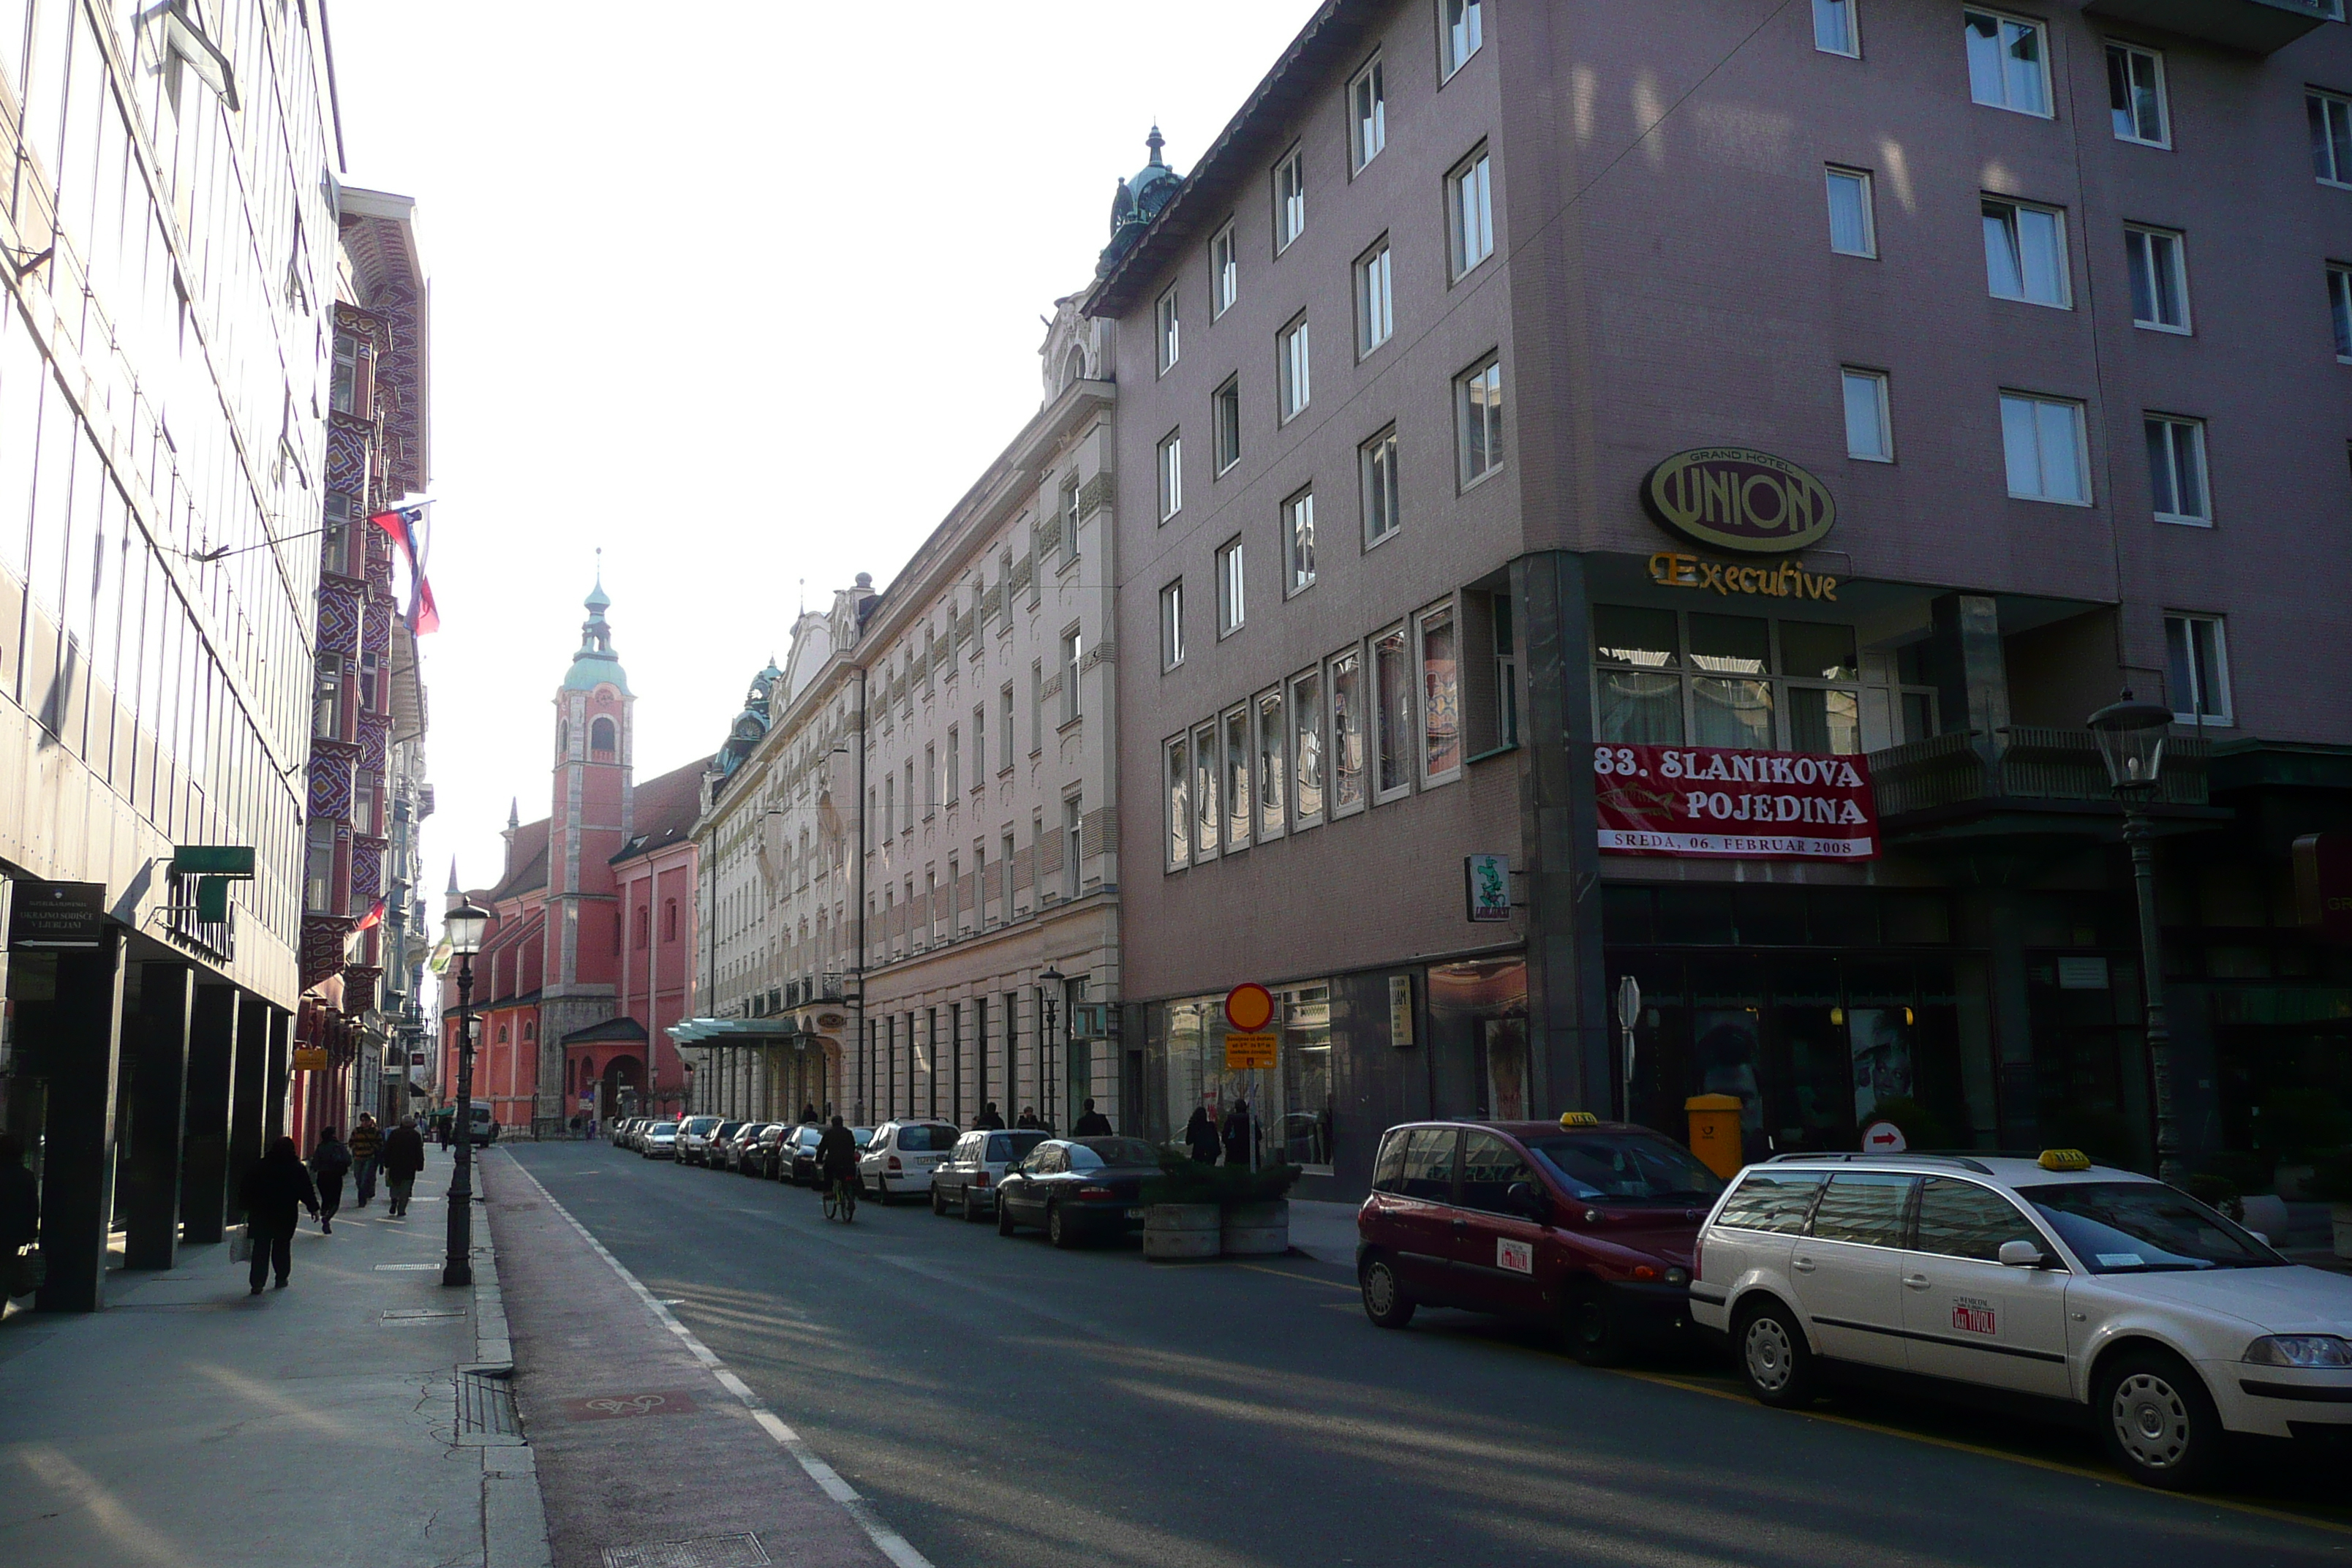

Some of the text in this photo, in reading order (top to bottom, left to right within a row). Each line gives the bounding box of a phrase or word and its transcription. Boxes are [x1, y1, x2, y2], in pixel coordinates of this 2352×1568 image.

[1689, 451, 1794, 474] GRAND HOTEL
[1673, 464, 1815, 533] UNION
[1649, 551, 1838, 602] Executive
[1594, 747, 1865, 788] 83. SLANIKOVA
[1686, 791, 1869, 825] POJEDINA
[1614, 833, 1852, 853] SREDA, 06. FEBRUAR 2008
[20, 911, 94, 921] OKRAJNO SODIŠČE
[39, 921, 81, 929] LJUBLJANI
[2054, 1151, 2084, 1163] TAXI
[1967, 1309, 1994, 1334] TIVOLI
